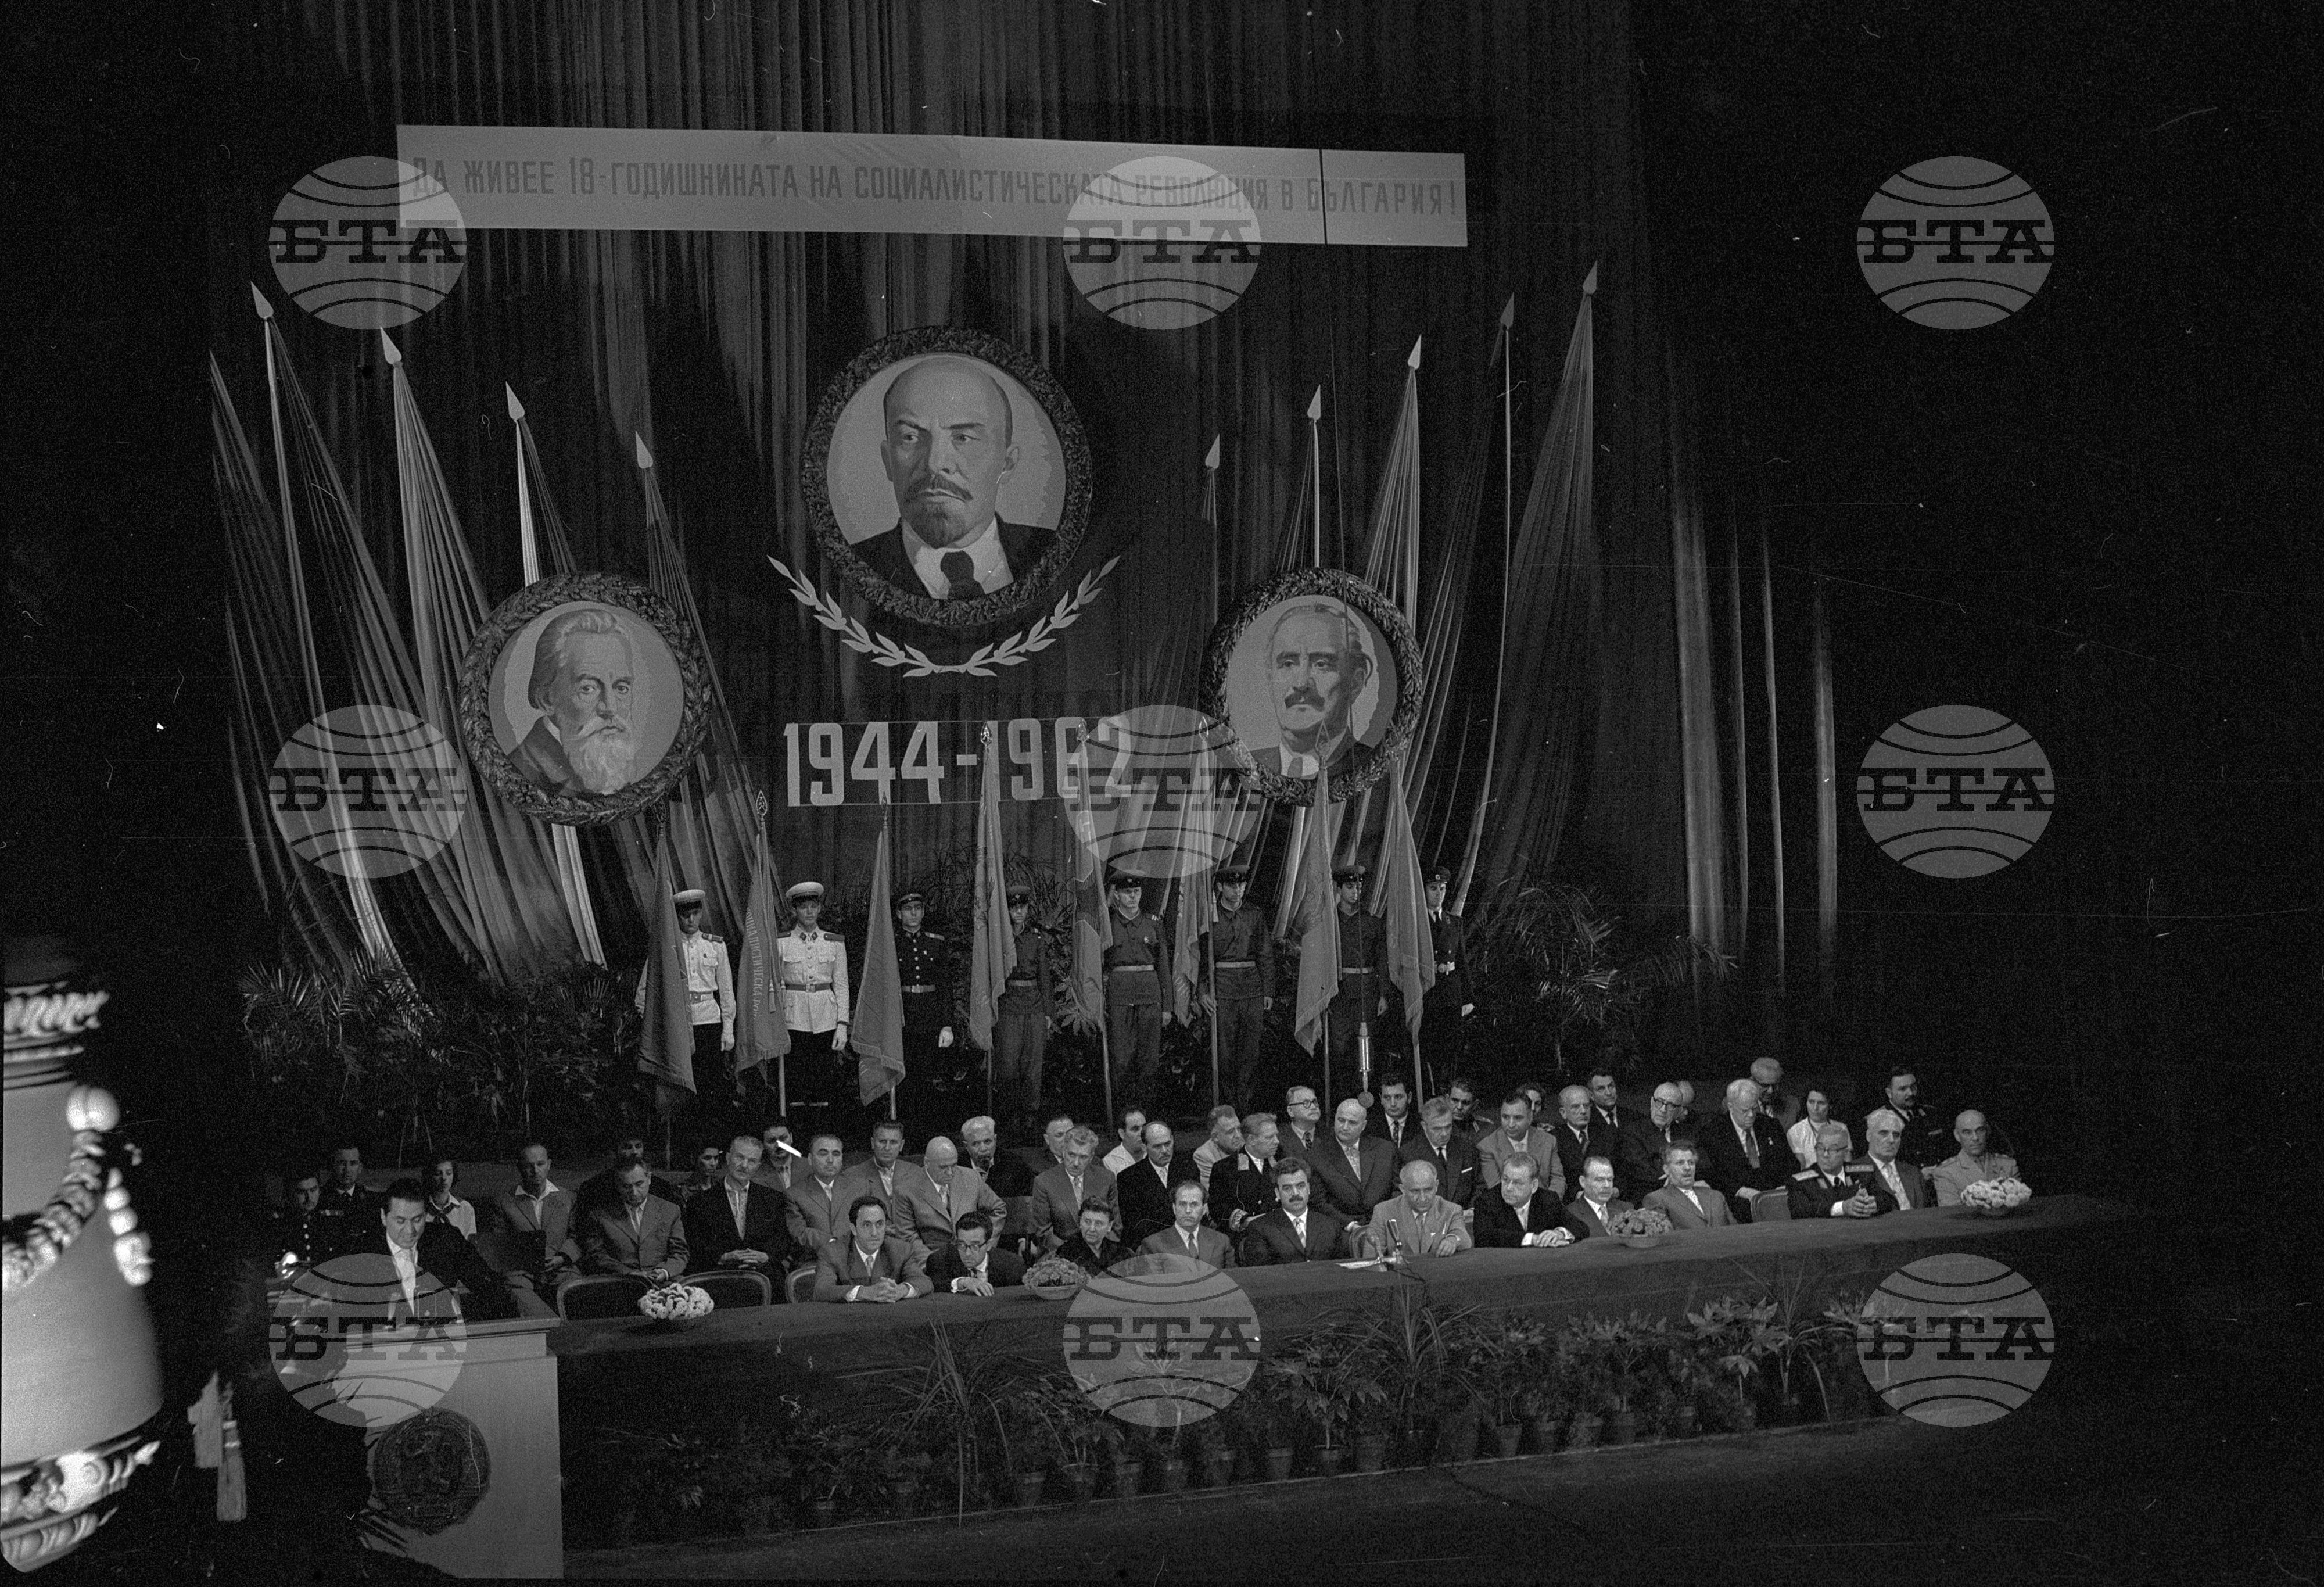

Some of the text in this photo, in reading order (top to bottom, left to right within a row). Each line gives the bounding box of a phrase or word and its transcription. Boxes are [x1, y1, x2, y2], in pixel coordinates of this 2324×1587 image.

[413, 157, 449, 197] ДА
[463, 160, 554, 194] ЖИВЕЕ
[569, 157, 798, 200] 18-ГОДИШНИНАТА
[810, 166, 842, 198] НА
[855, 167, 1122, 205] СОЦИАЛИСТИЧЕСКАТА
[1135, 175, 1268, 213] РЕВОЛЮЦИЯ
[1281, 179, 1293, 210] В
